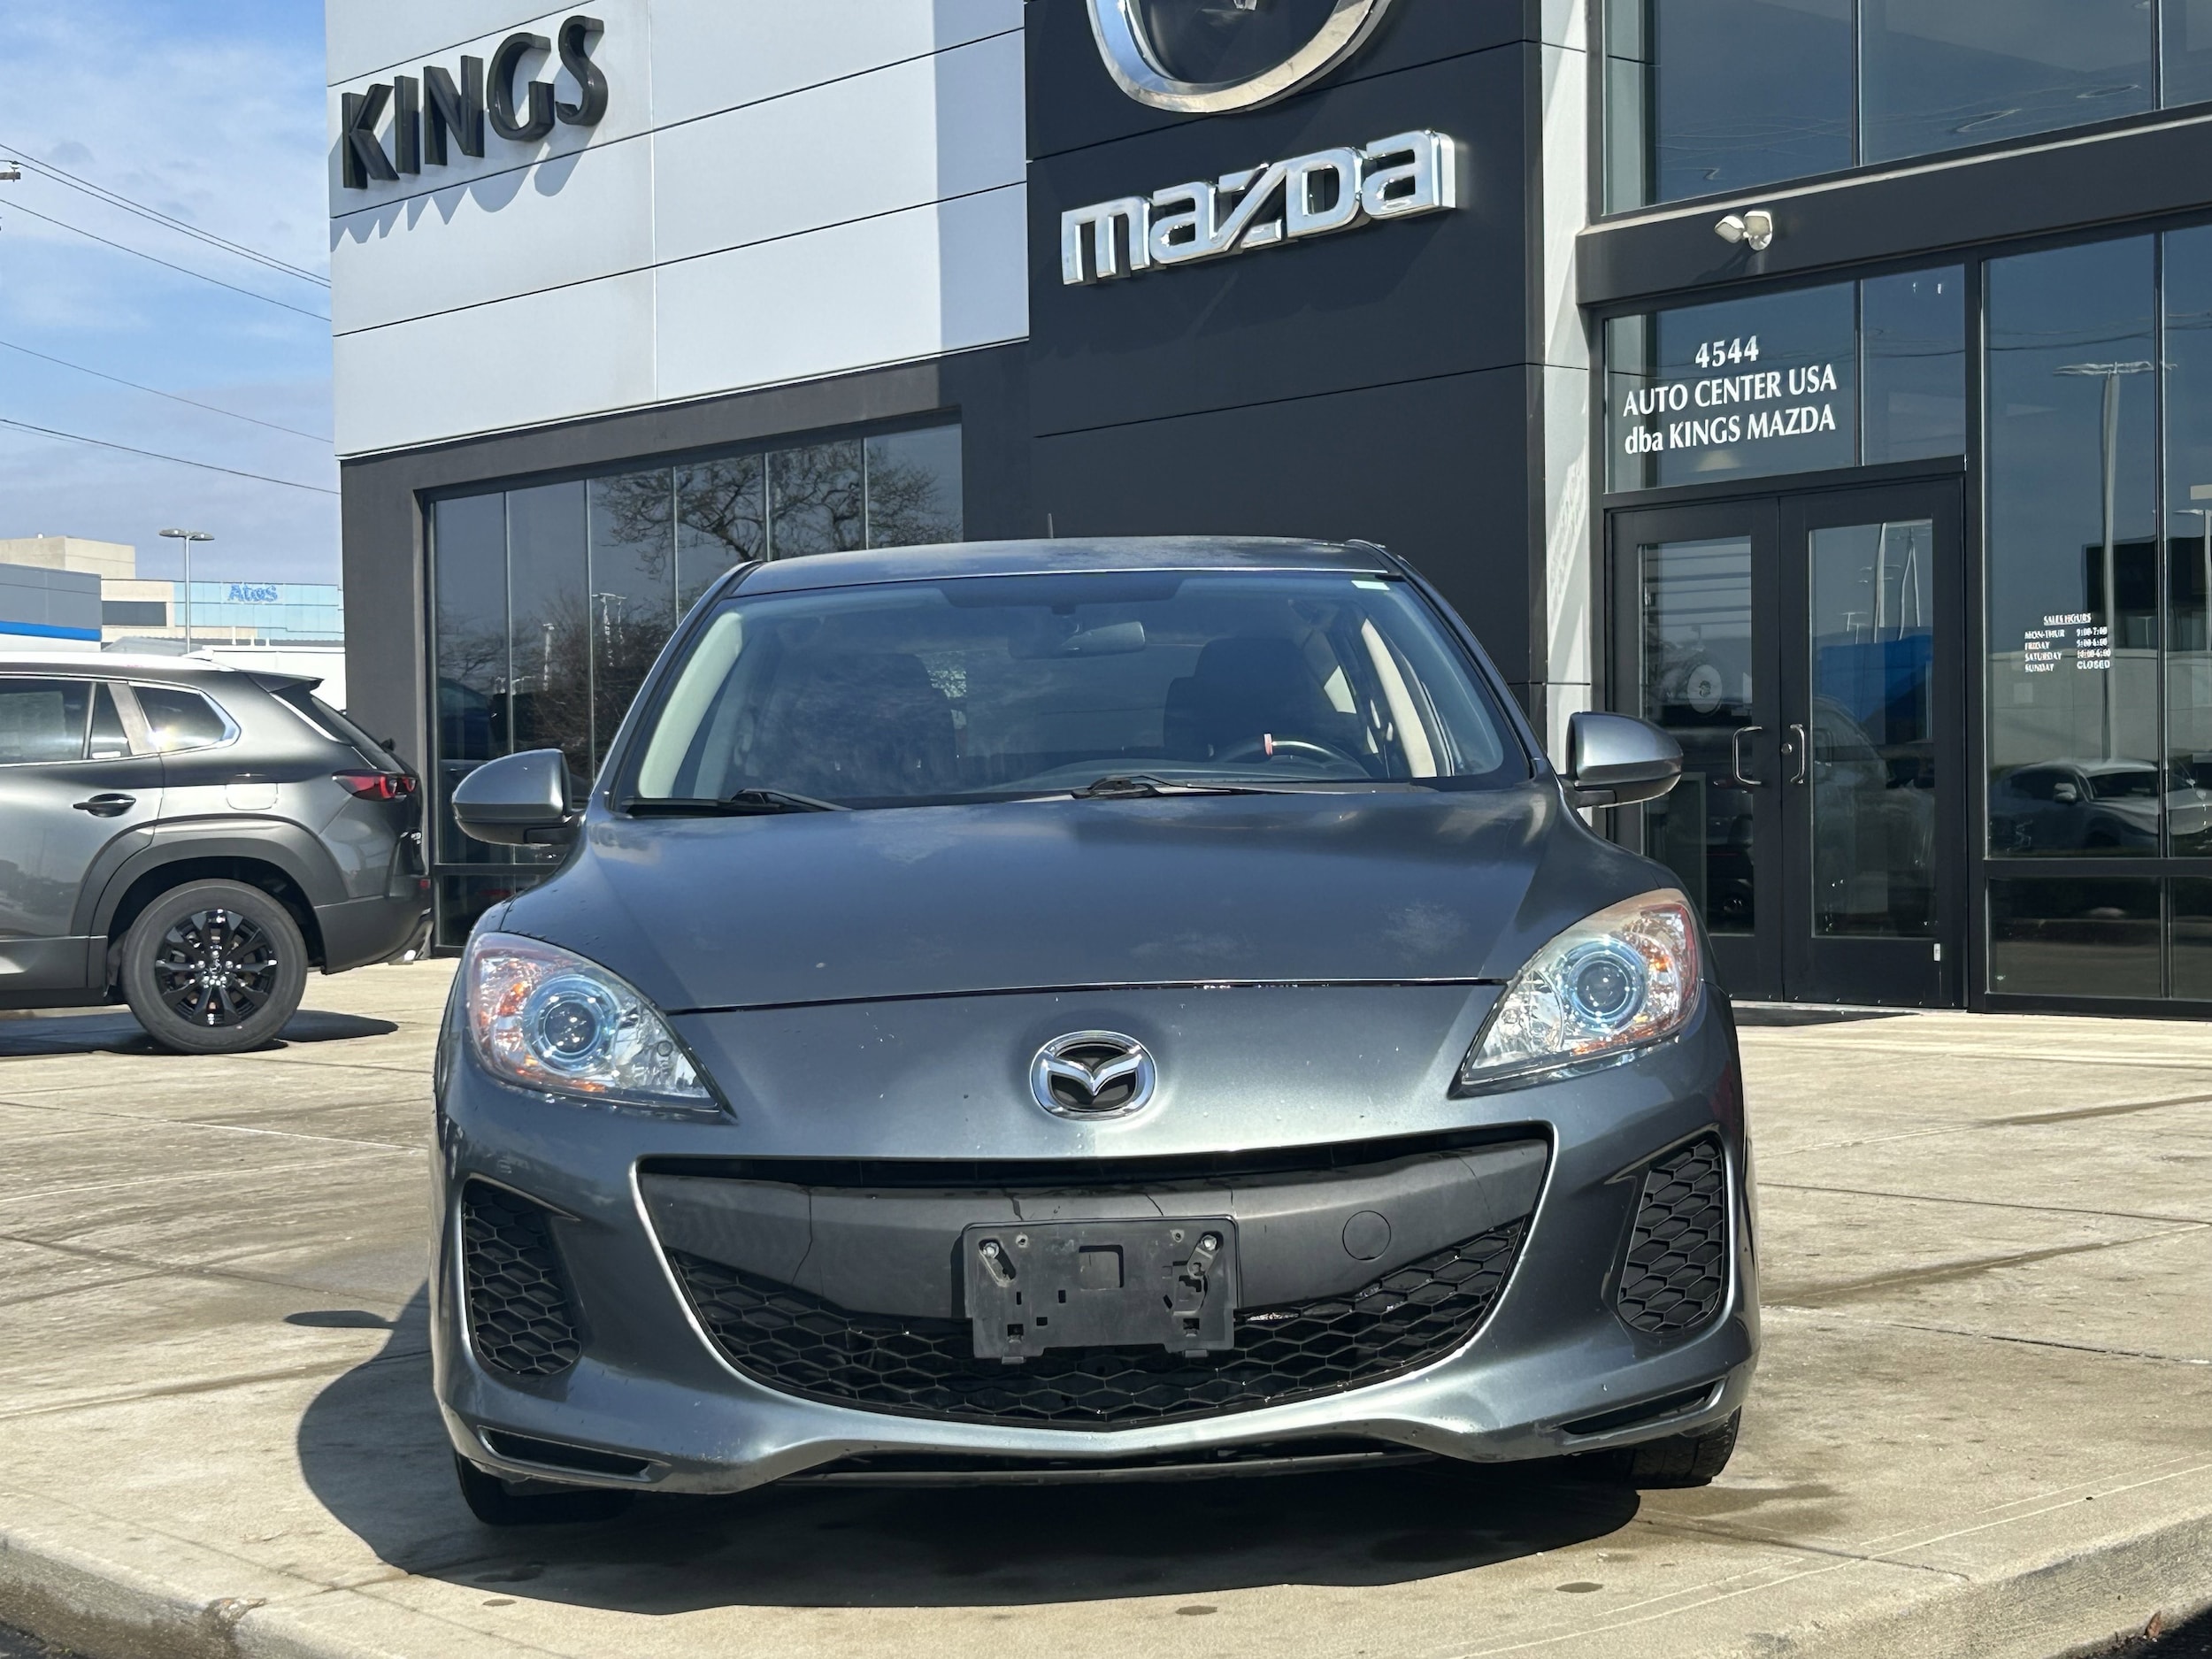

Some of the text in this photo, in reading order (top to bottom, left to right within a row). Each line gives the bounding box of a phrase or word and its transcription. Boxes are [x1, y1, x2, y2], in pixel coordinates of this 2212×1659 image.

[342, 15, 609, 189] KINGS
[1694, 335, 1759, 368] 4544
[1623, 364, 1838, 417] AUTO CENTER USA
[1624, 403, 1836, 455] dba KINGS MAZDA
[2077, 660, 2111, 670] CLOSED
